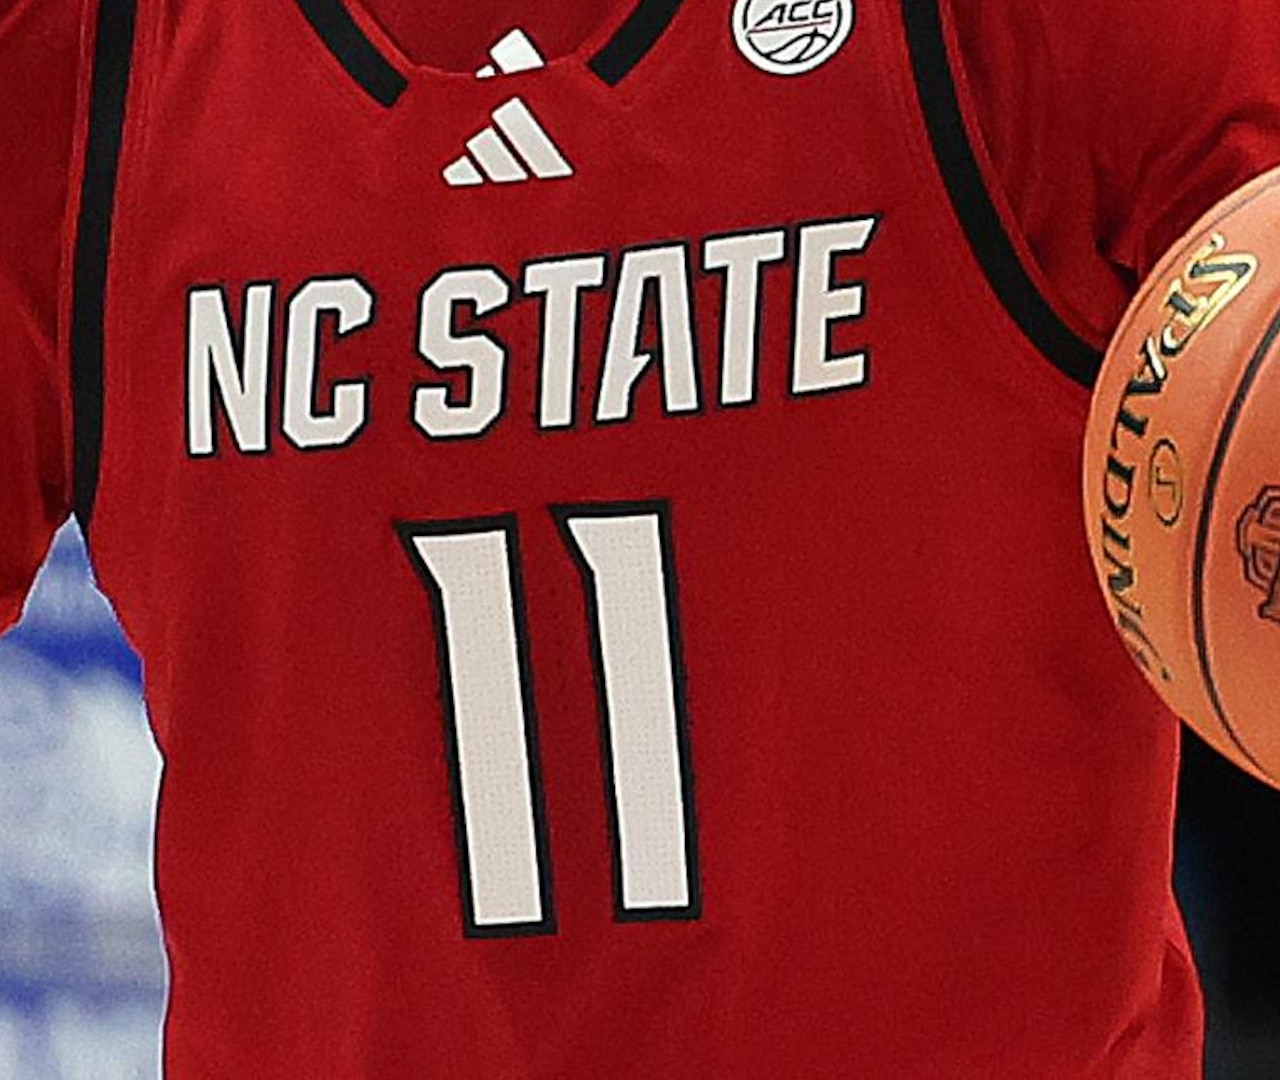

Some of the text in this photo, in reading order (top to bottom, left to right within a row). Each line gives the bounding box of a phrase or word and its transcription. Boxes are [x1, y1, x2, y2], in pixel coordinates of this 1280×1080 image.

[187, 214, 882, 458] NC STATE
[1100, 231, 1258, 681] SPALDING
[394, 499, 703, 938] 11
